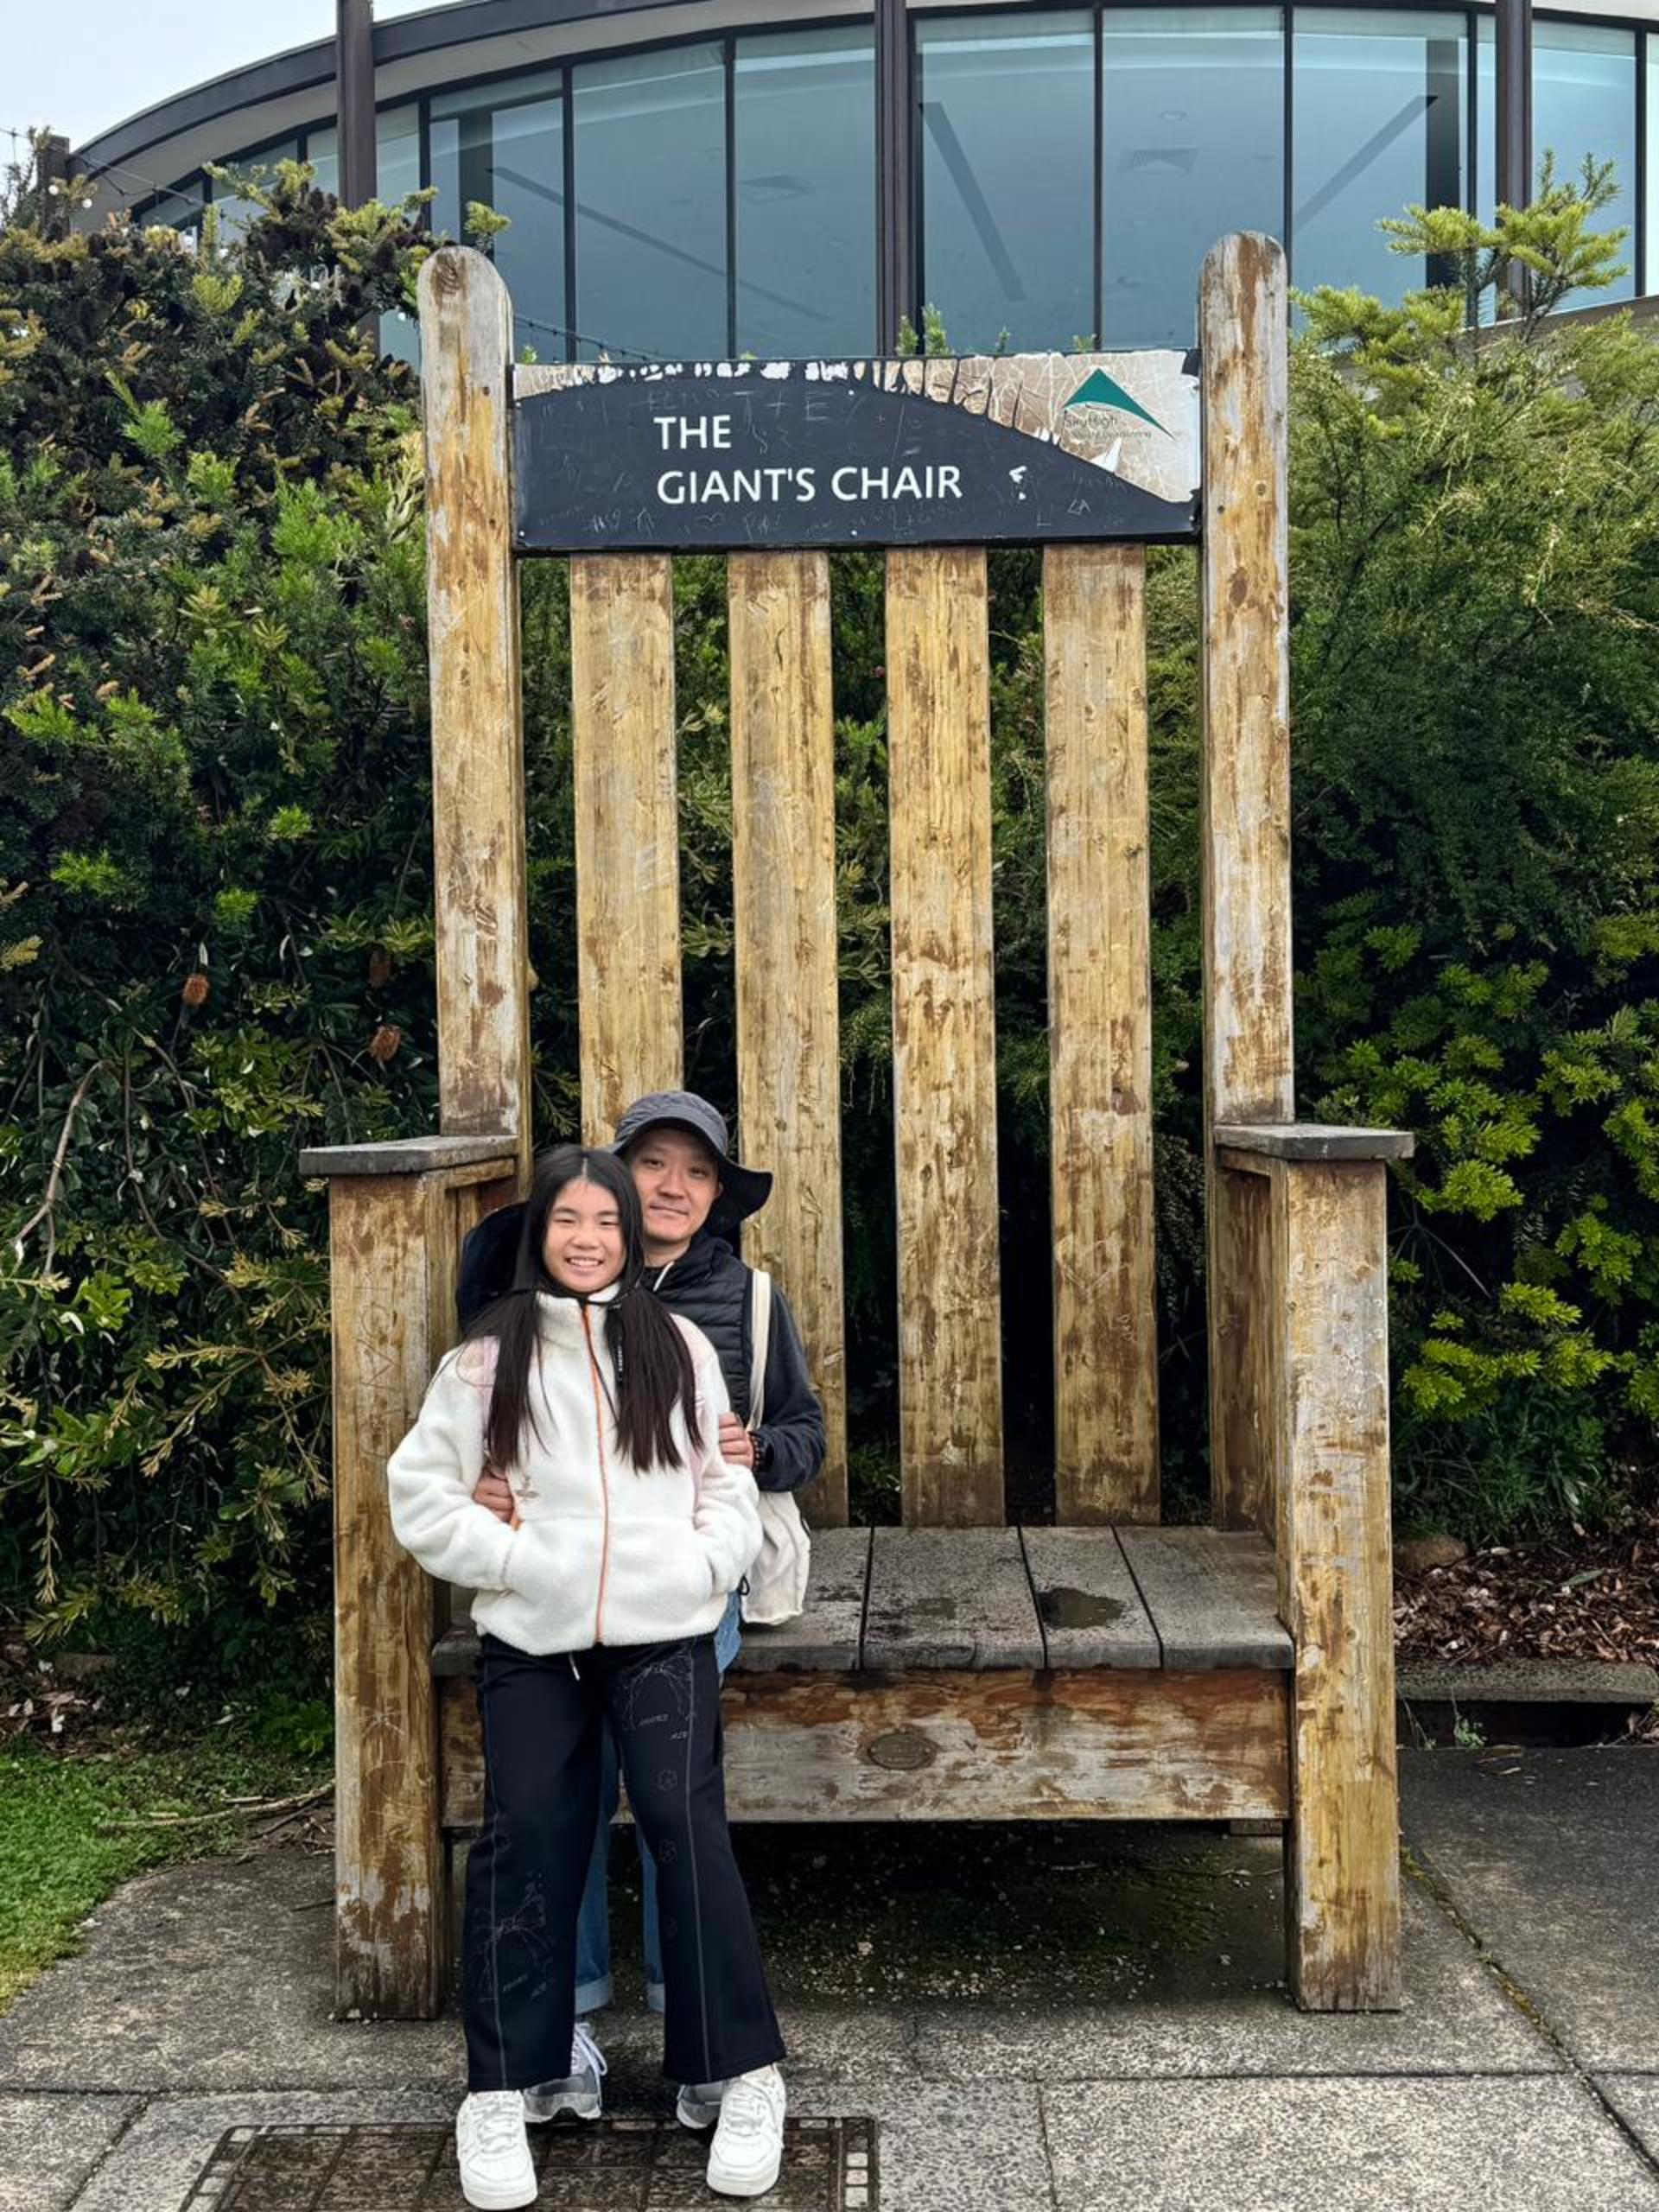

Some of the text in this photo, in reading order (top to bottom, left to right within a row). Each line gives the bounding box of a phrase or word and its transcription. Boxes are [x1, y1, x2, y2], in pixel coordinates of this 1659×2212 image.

[653, 414, 732, 450] THE
[657, 465, 963, 505] GIANT'S CHAIR
